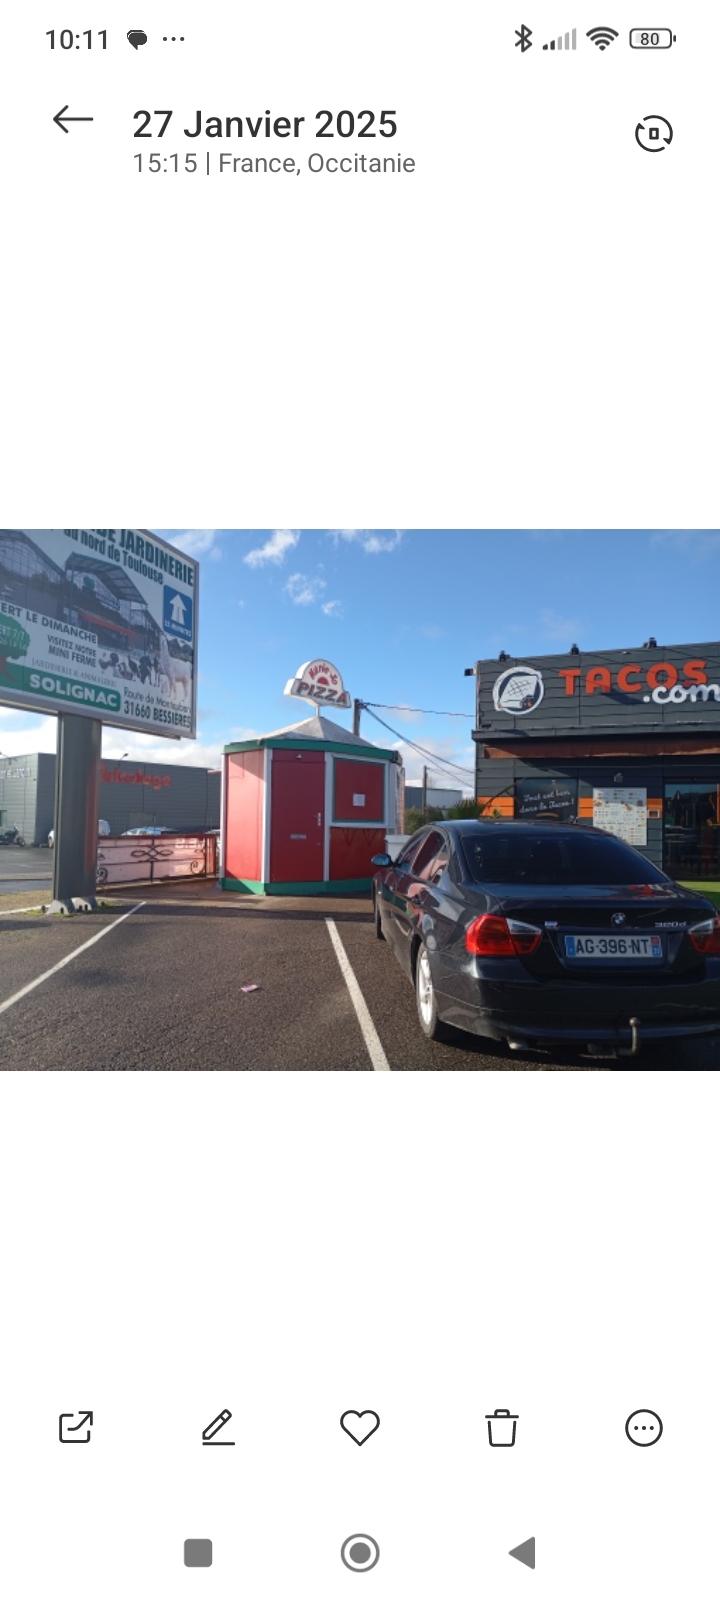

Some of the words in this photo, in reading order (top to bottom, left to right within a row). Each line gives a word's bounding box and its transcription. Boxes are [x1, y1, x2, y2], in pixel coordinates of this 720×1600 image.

[81, 530, 106, 556] nord
[107, 543, 121, 563] de
[122, 550, 163, 585] Toulouse
[119, 529, 194, 587] JARDINERIE
[26, 611, 38, 624] LE
[41, 616, 97, 644] DIMANCHE
[47, 634, 73, 650] VISITEZ
[74, 642, 97, 658] NOTRE
[48, 644, 70, 660] MINI
[71, 651, 96, 668] FERME
[558, 659, 709, 695] TACOS
[29, 674, 117, 707] SOLIGNAC
[123, 686, 144, 702] Route
[145, 693, 155, 705] de
[296, 682, 348, 705] PIZZA
[642, 683, 720, 704] .com
[123, 700, 151, 719] 31660
[575, 938, 649, 955] AG-396-NT
